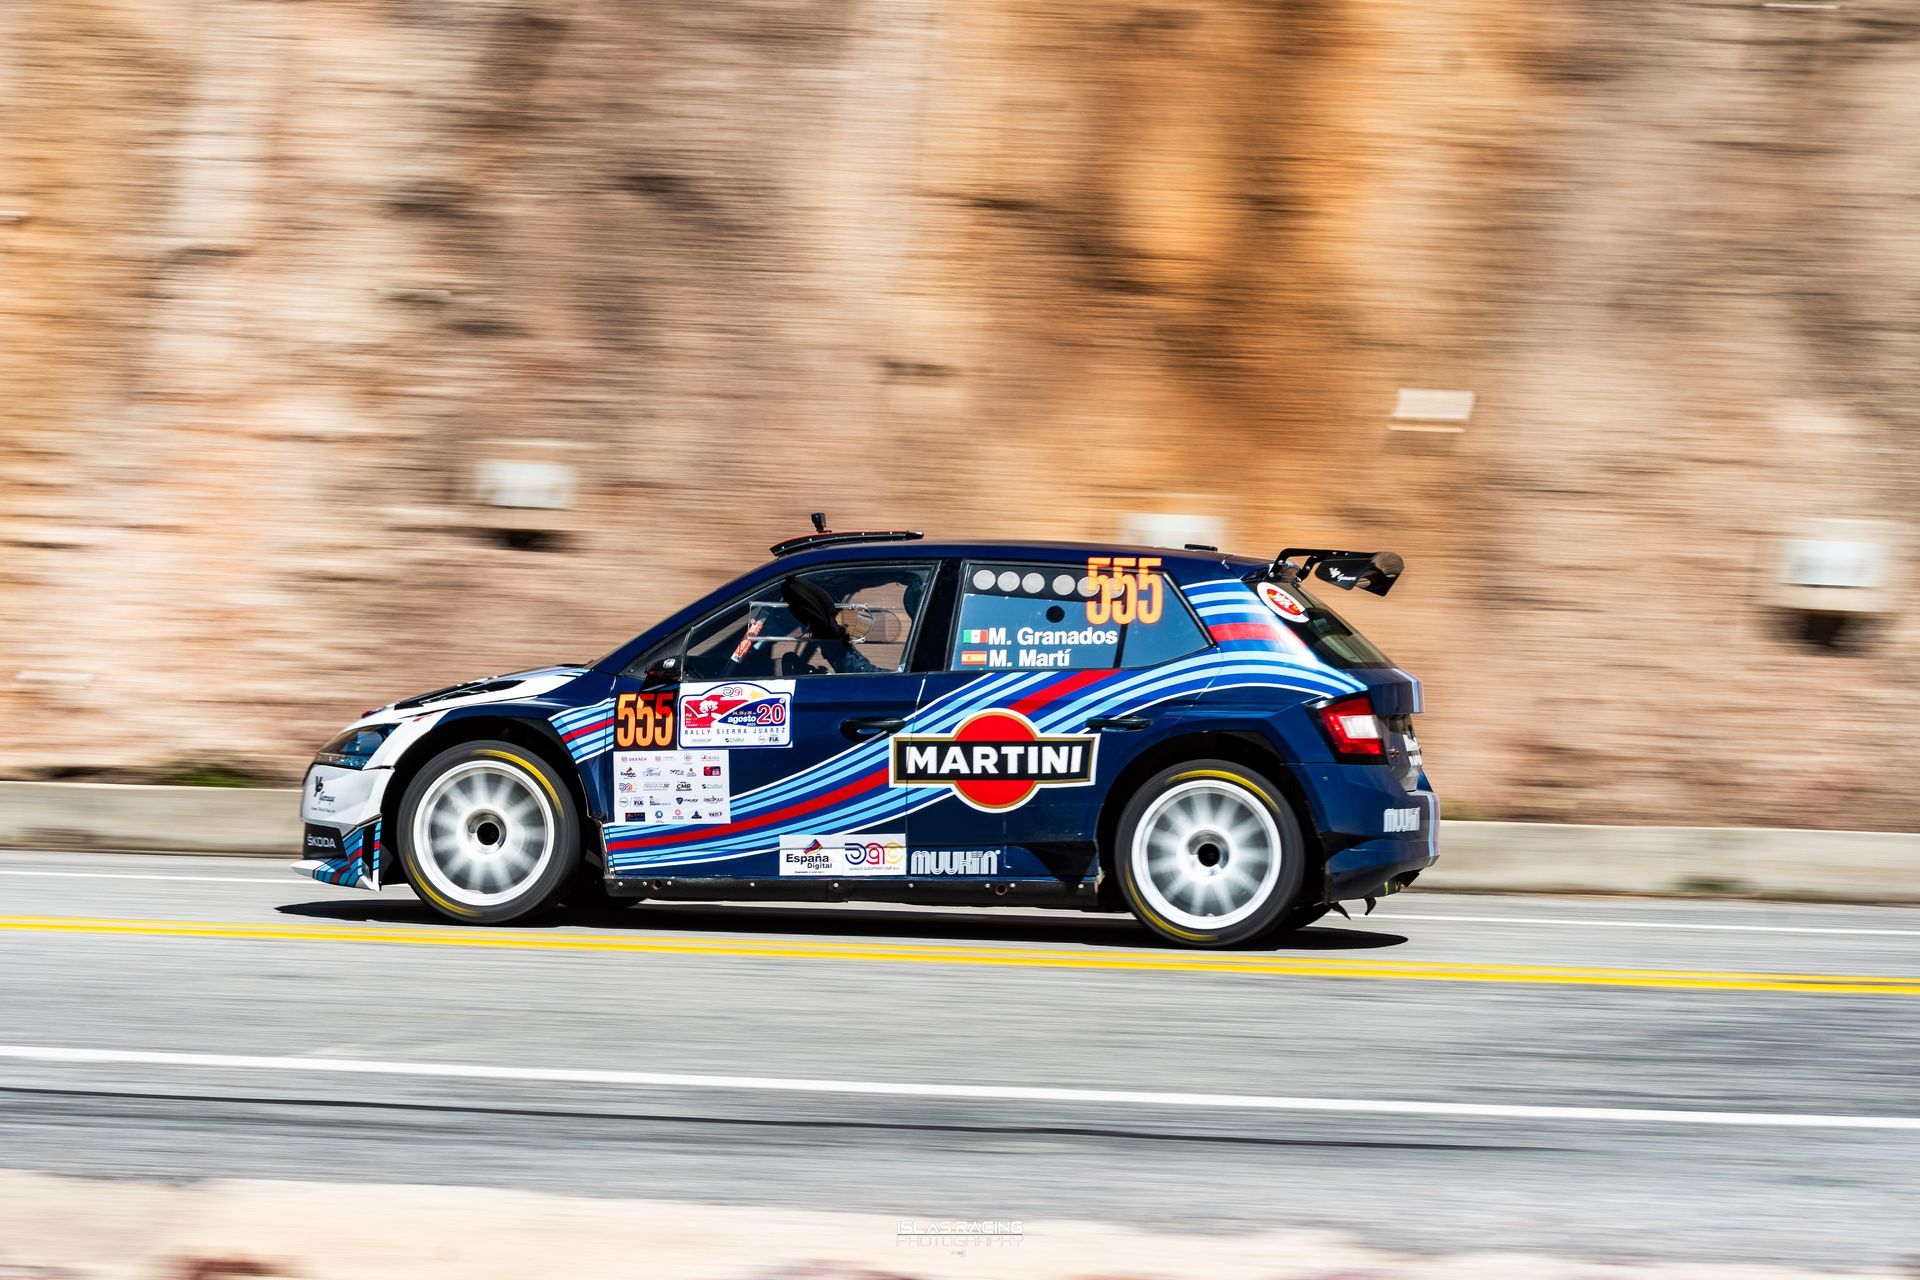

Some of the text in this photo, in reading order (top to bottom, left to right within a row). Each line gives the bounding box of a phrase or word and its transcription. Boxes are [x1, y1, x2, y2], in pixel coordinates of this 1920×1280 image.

[1086, 557, 1164, 625] 555
[988, 626, 1119, 646] M. Granados
[988, 648, 1072, 667] M. Martí
[617, 693, 674, 747] 555
[727, 714, 757, 725] agosto
[757, 703, 785, 724] 20
[906, 745, 1083, 774] MARTINI
[786, 853, 829, 864] España
[807, 862, 832, 870] Digital
